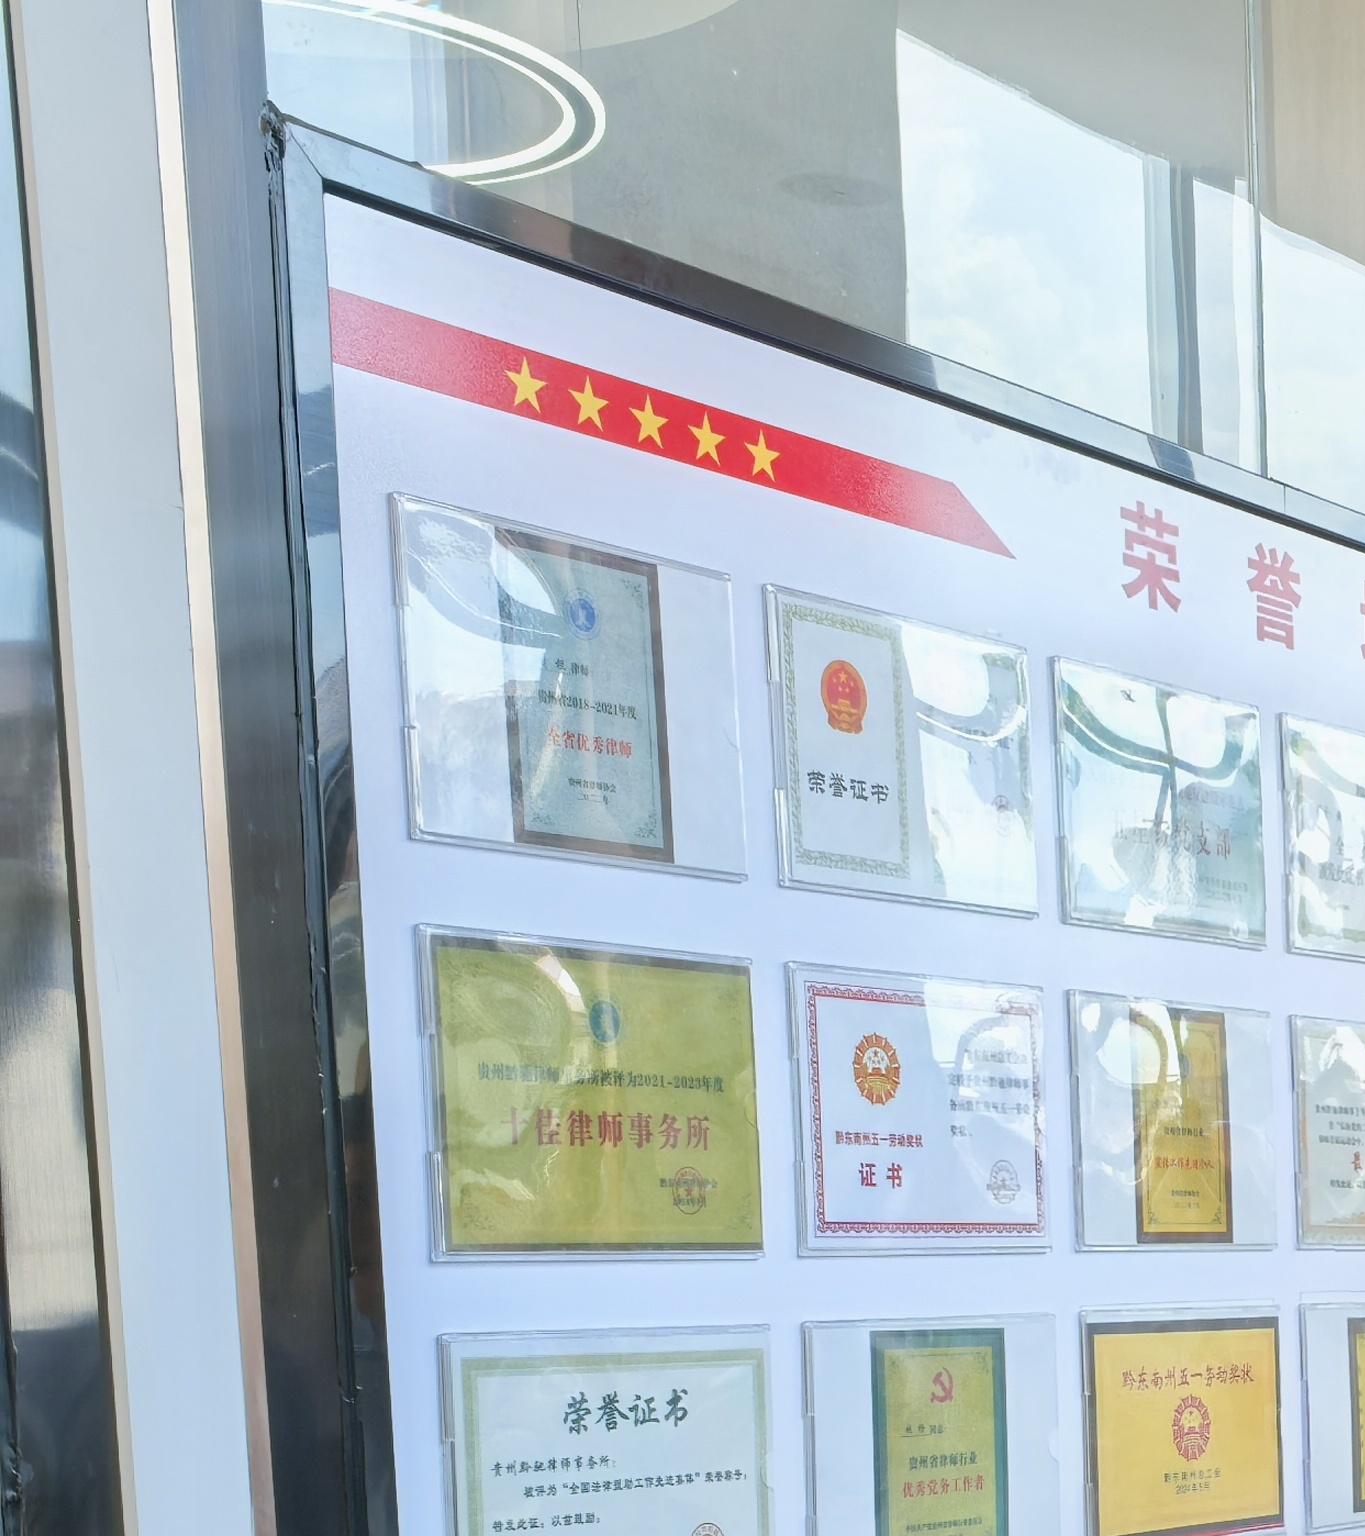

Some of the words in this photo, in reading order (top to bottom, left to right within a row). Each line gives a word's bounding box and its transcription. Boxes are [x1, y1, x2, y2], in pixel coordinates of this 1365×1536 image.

[548, 728, 633, 758] 全省优秀律师
[806, 770, 890, 804] 荣誉证书
[501, 1106, 711, 1151] 十佳律师事务所
[835, 1130, 924, 1148] 黔东南州五一劳动奖状
[858, 1162, 904, 1189] 证书
[1121, 1362, 1255, 1391] 黔东南州五一劳动奖状
[563, 1388, 689, 1436] 荣誉证书
[908, 1451, 978, 1471] 贵州省律师行业
[902, 1474, 985, 1499] 优秀党务工作者
